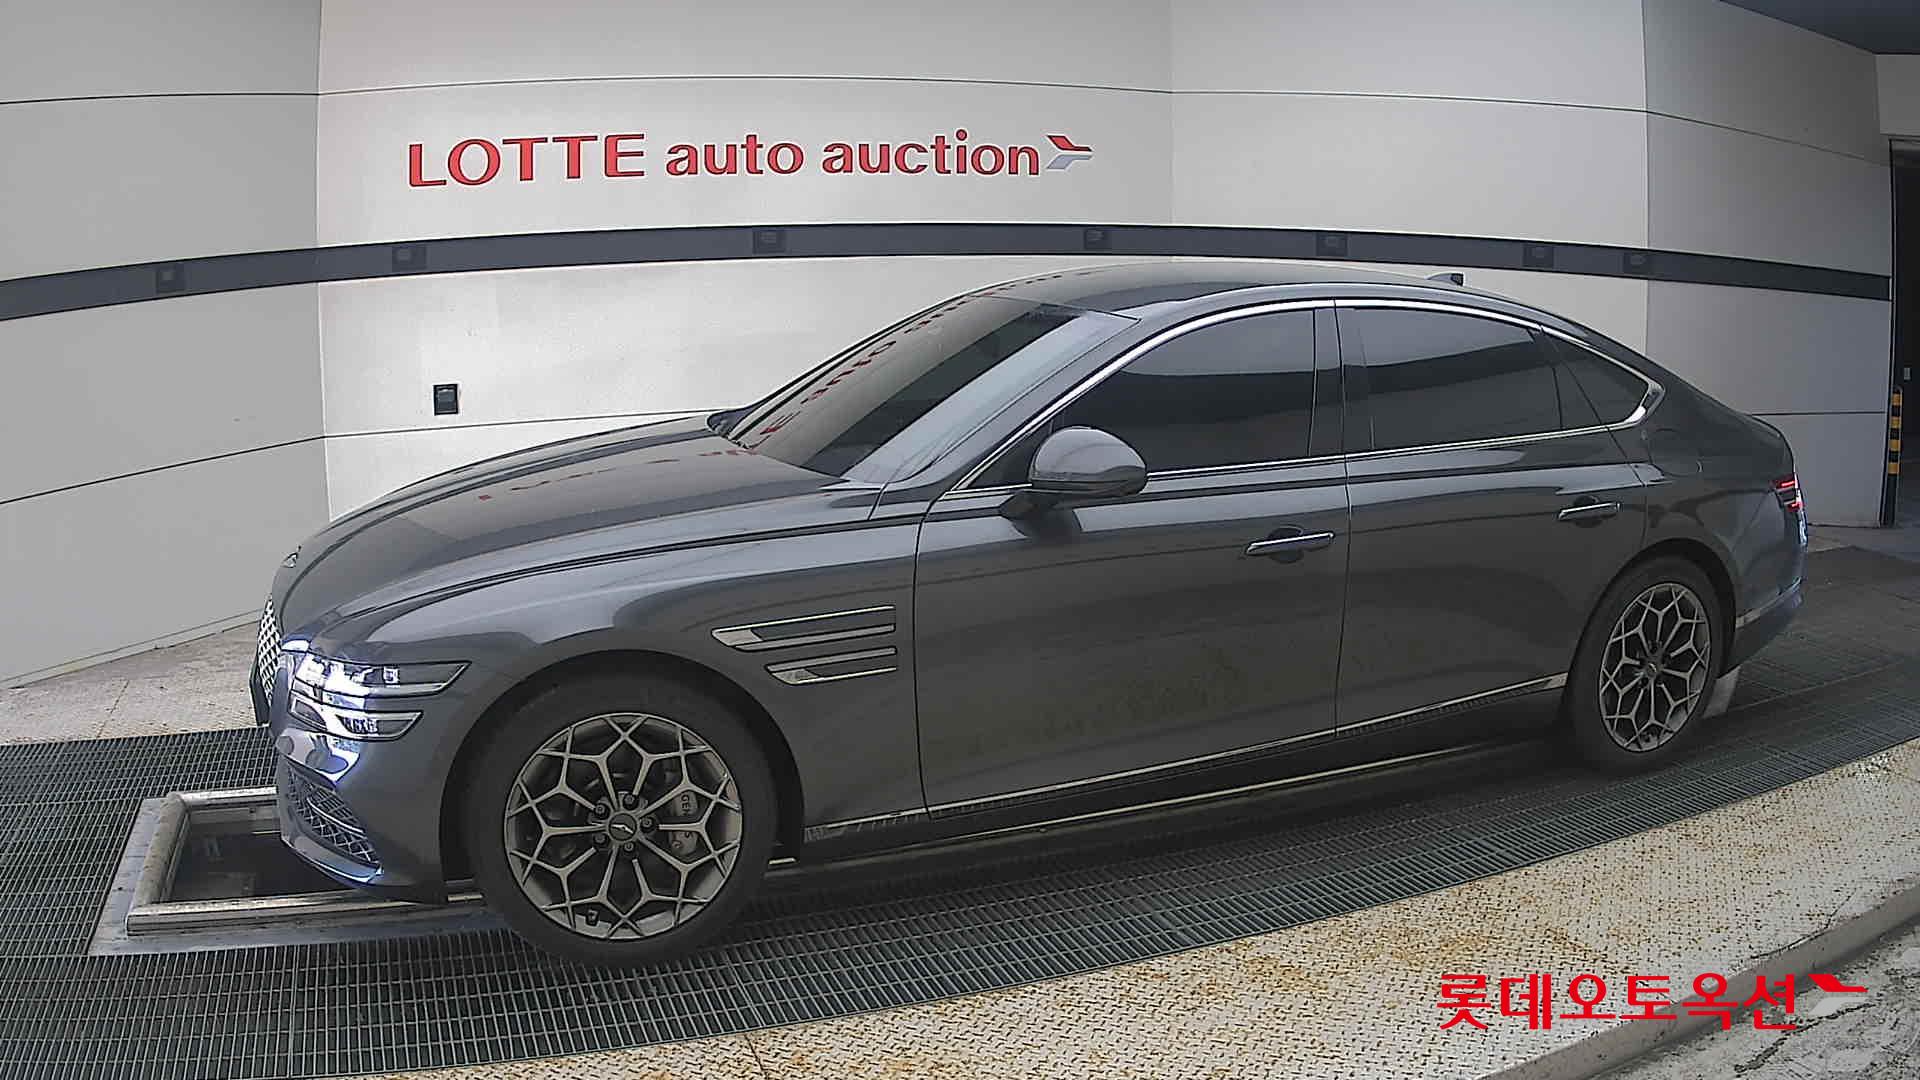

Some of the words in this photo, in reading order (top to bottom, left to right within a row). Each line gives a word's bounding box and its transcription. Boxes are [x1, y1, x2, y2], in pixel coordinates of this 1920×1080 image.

[409, 134, 645, 188] LOTTE
[666, 134, 804, 176] auto
[822, 129, 1039, 176] auction
